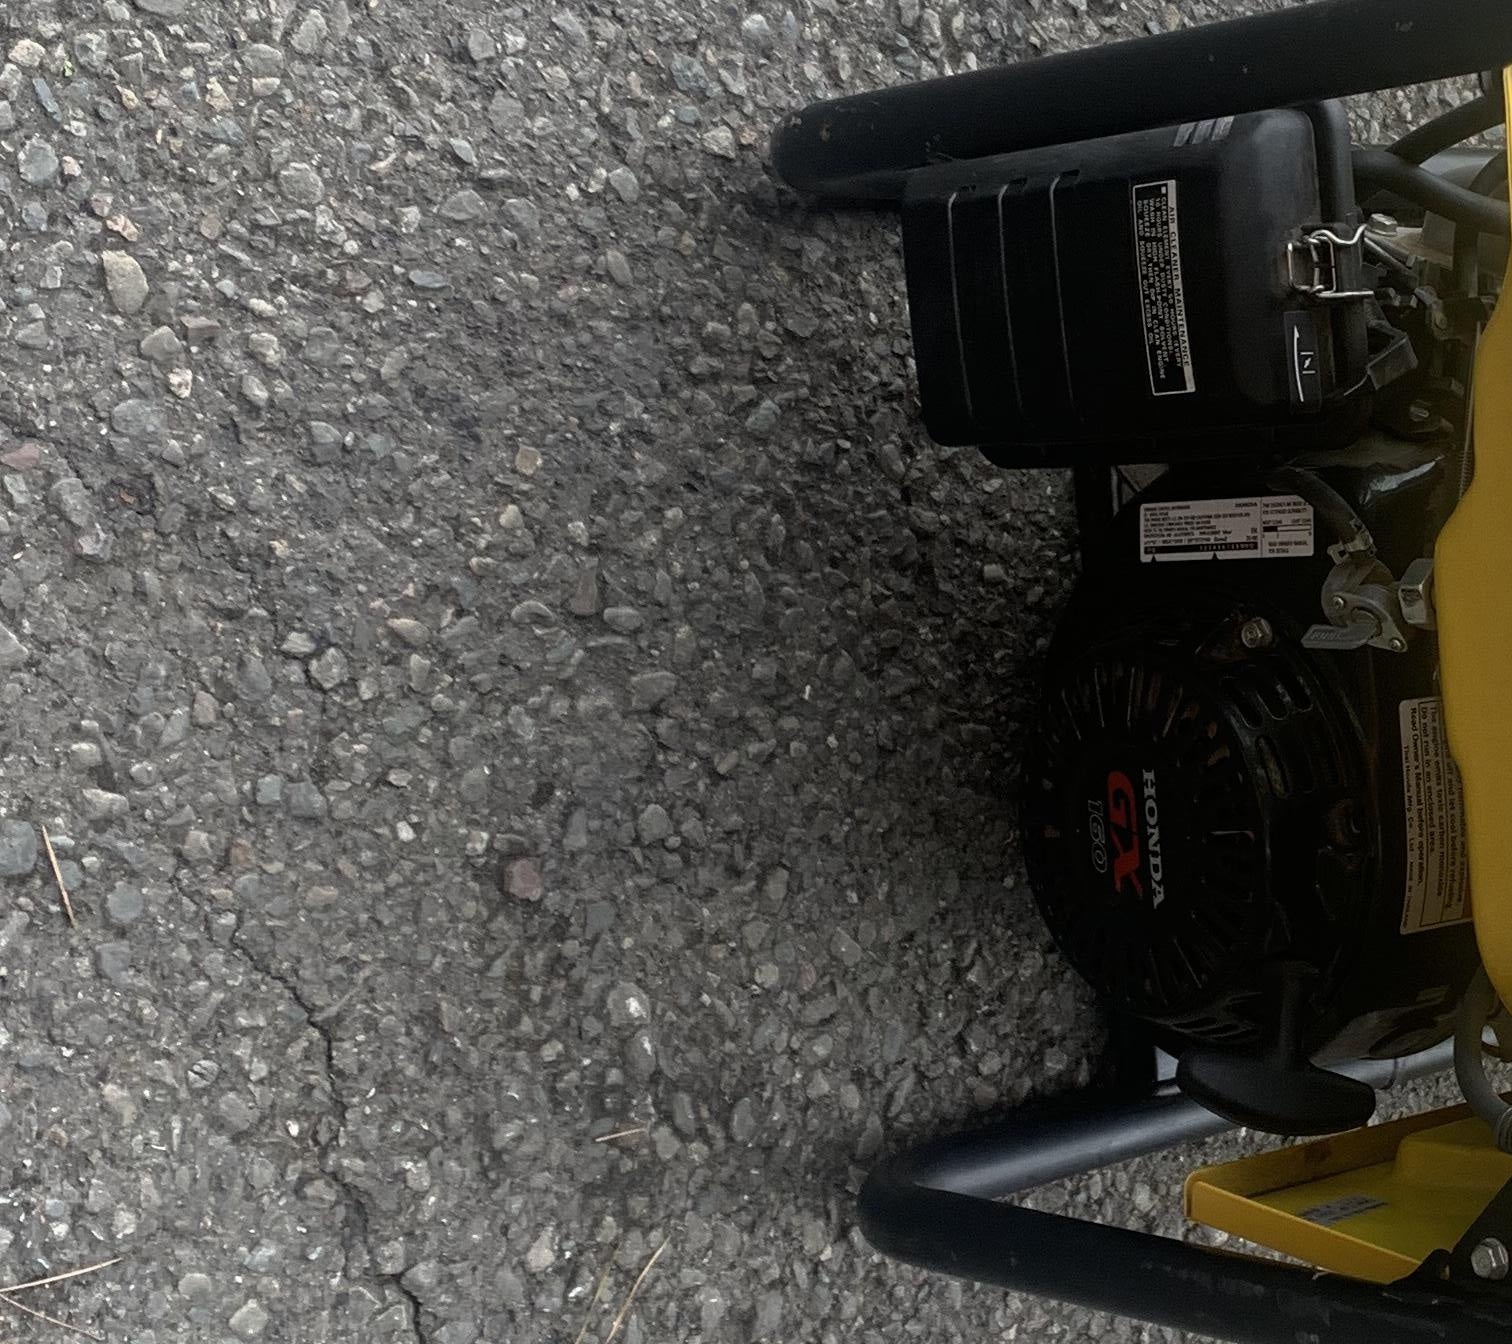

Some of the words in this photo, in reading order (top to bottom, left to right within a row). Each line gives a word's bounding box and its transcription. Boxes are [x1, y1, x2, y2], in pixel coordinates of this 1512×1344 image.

[1169, 231, 1180, 280] CLEANER
[1174, 287, 1189, 366] MAINTENANCE
[1414, 772, 1422, 805] Manual
[1416, 807, 1424, 837] before
[1088, 799, 1108, 873] 160
[1107, 770, 1144, 899] GX
[1142, 769, 1165, 909] HONDA
